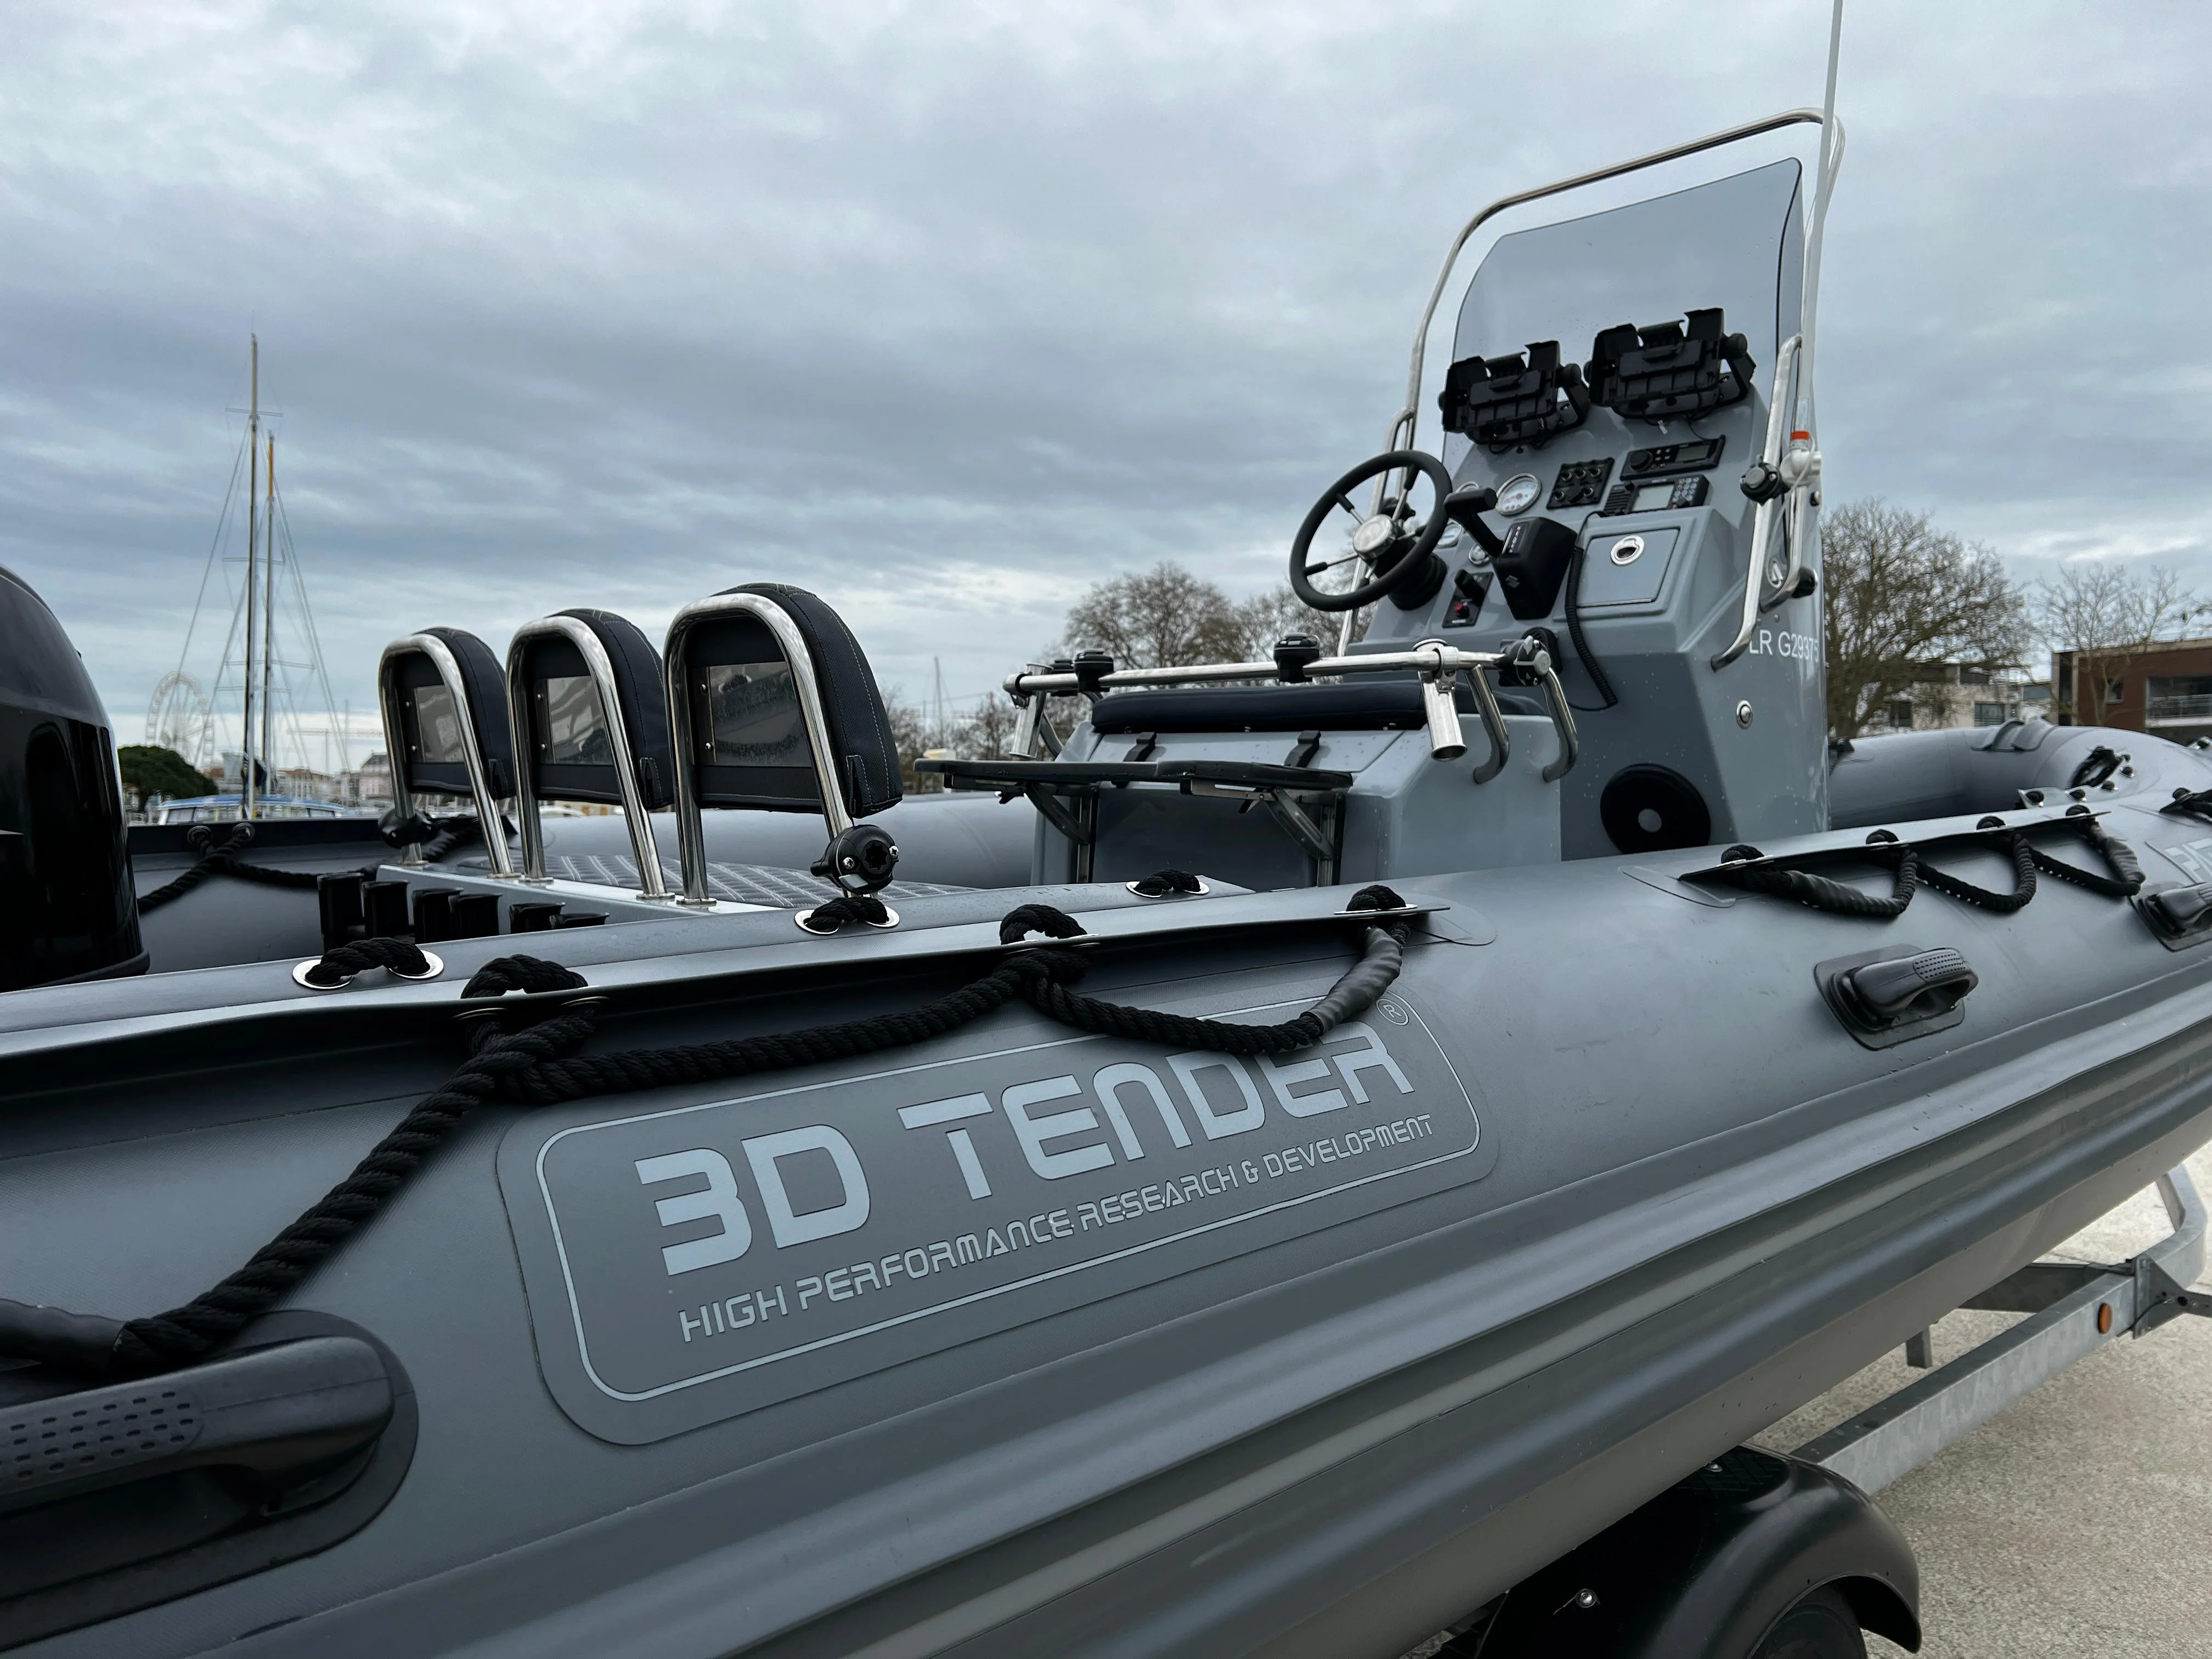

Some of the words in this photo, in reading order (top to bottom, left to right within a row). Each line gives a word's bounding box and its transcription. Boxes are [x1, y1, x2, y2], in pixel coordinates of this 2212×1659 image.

[1749, 629, 1773, 656] LR
[1778, 631, 1819, 663] G29375
[634, 1124, 871, 1276] 3D
[896, 1020, 1415, 1200] TENDER
[678, 1285, 788, 1342] HIGH
[795, 1208, 1074, 1310] PERFORMANCE
[1076, 1164, 1240, 1231] RESEARCH
[1241, 1160, 1260, 1183] &
[1262, 1113, 1433, 1178] DEVELOPMENT
